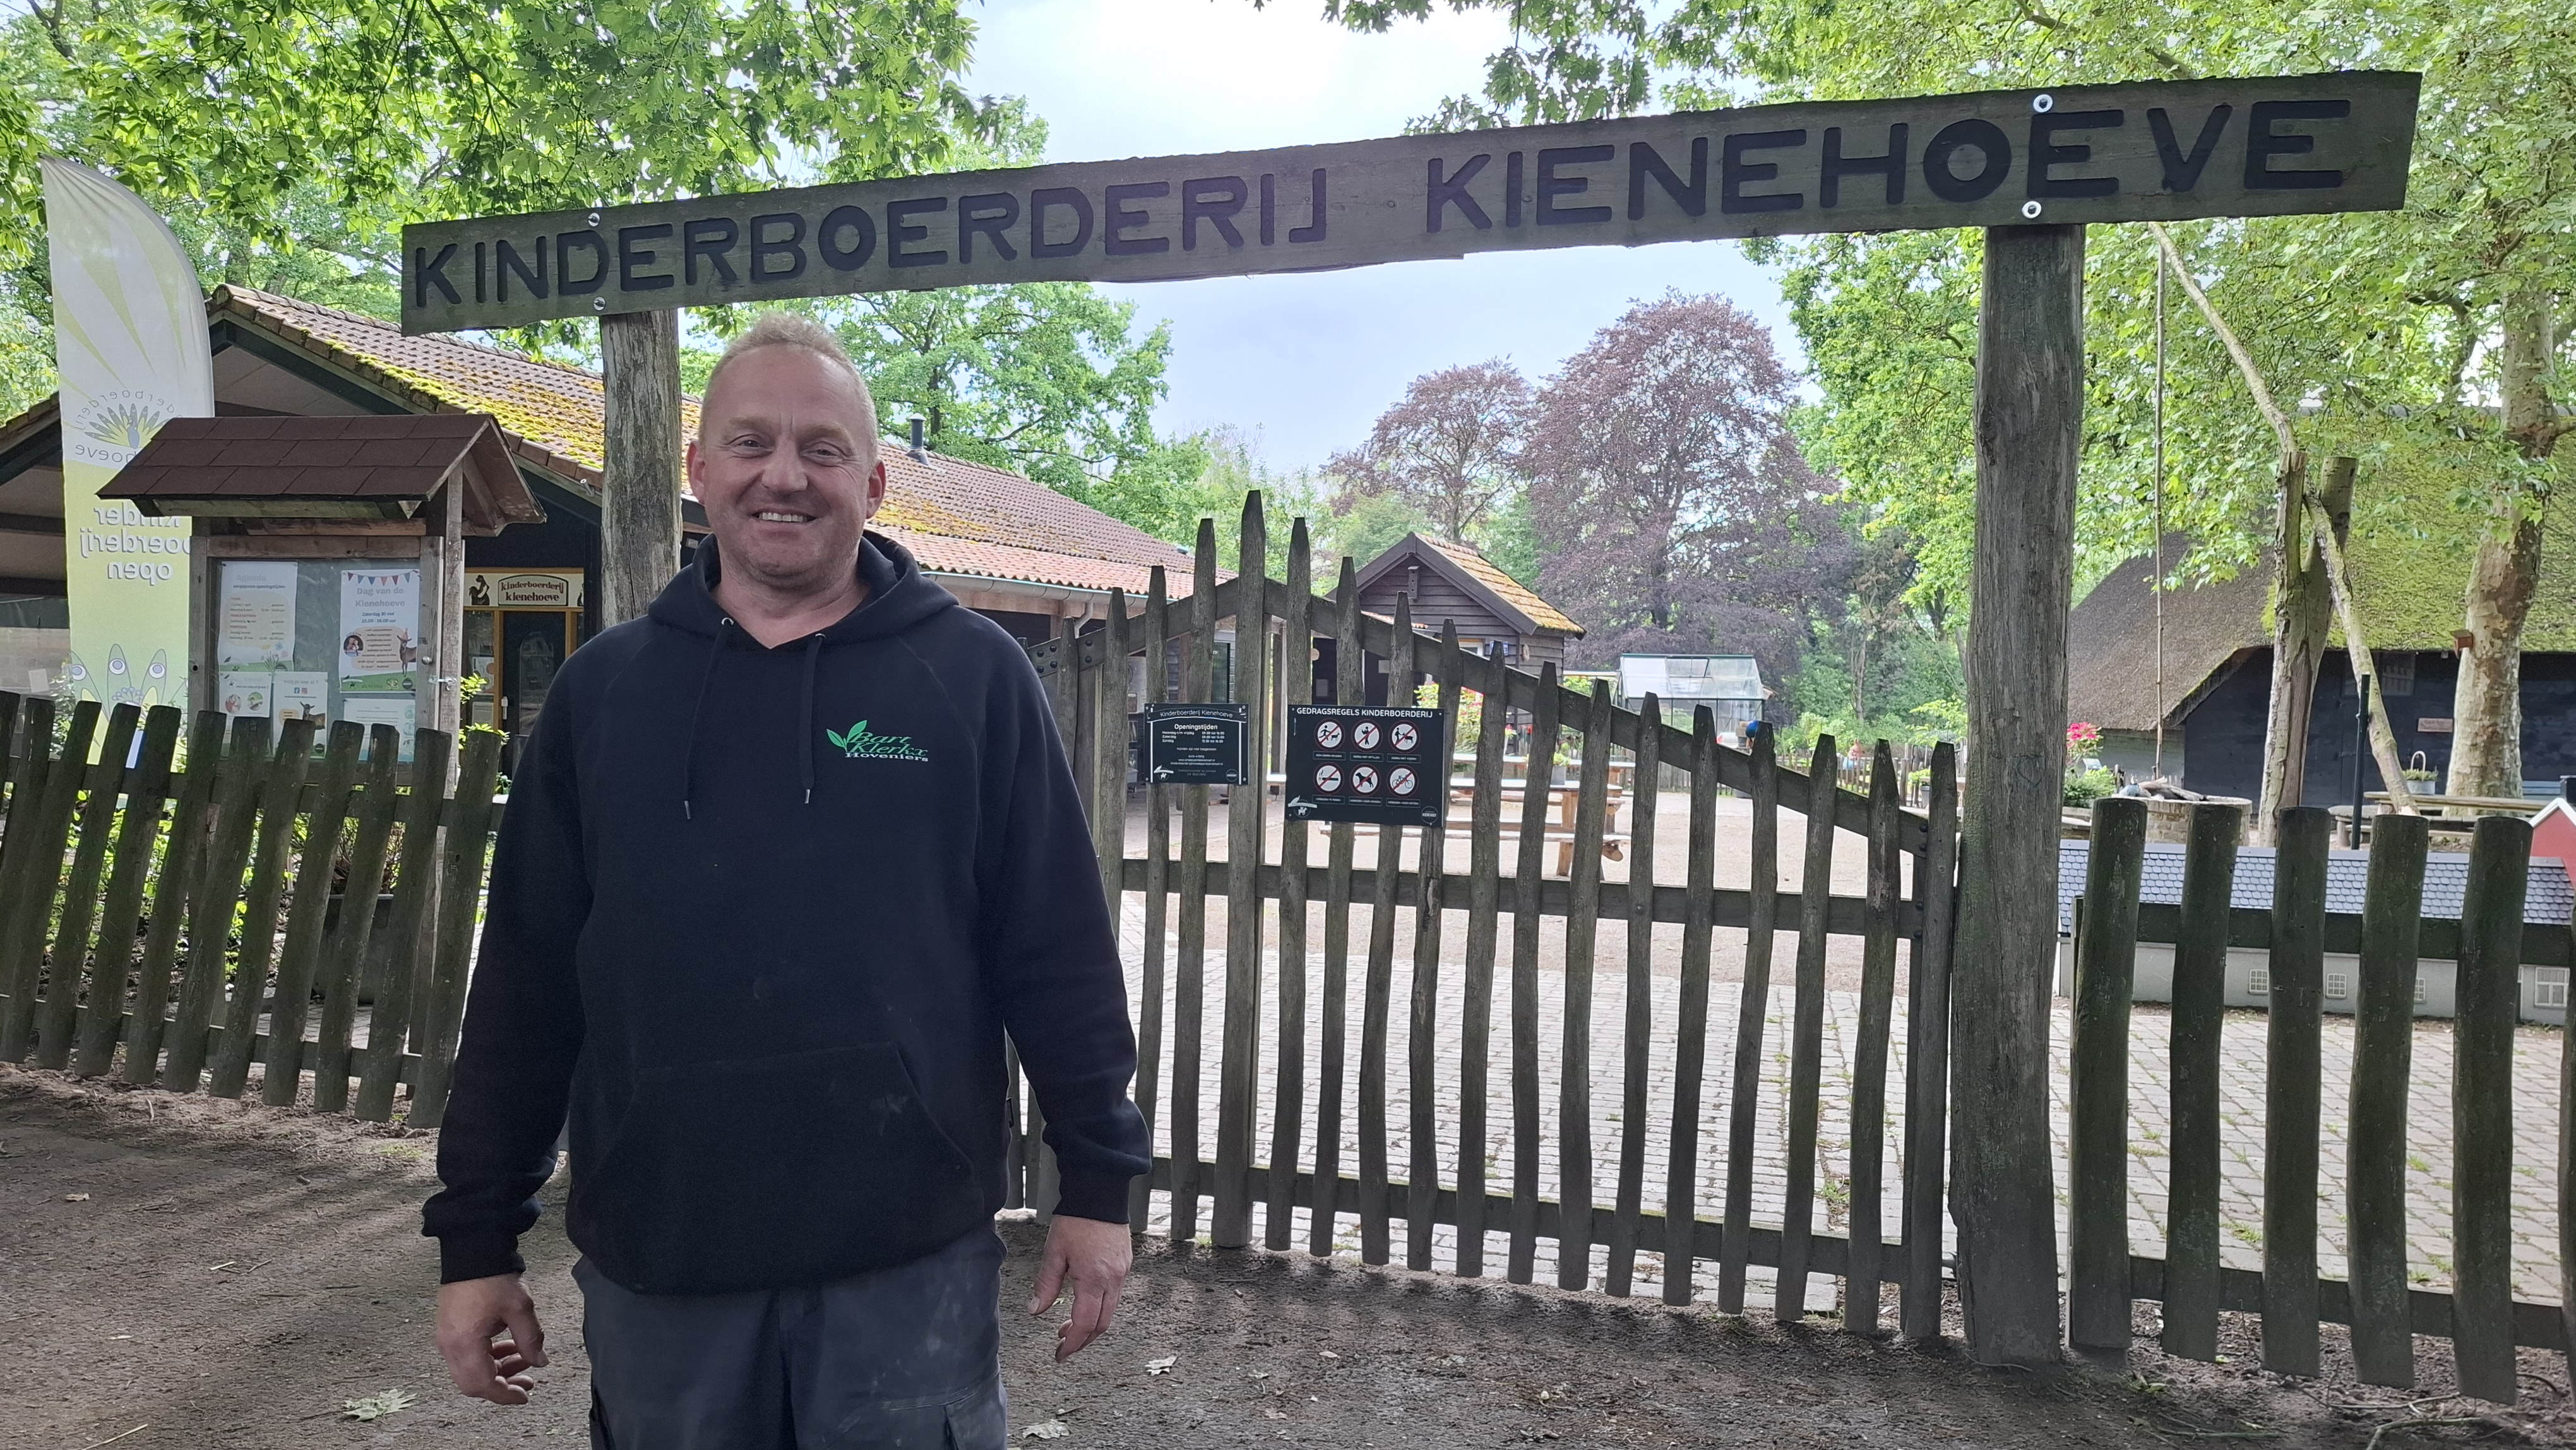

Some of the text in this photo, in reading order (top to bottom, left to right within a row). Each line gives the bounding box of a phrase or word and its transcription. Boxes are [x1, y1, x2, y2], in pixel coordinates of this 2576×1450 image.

[415, 99, 2352, 307] KINDERBOERDERIJ KIENEHOEVE
[357, 588, 373, 596] Dag
[501, 580, 564, 594] kinderboerderij
[506, 592, 559, 601] kienehoeve
[1160, 709, 1233, 718] Kinderboerderij Kienehoeve
[1296, 707, 1433, 718] GEDRAGSREGELS KINDERBOERDERIJ
[848, 731, 913, 743] Bart
[849, 742, 929, 757] Klerkx
[845, 752, 929, 762] Hoveniers
